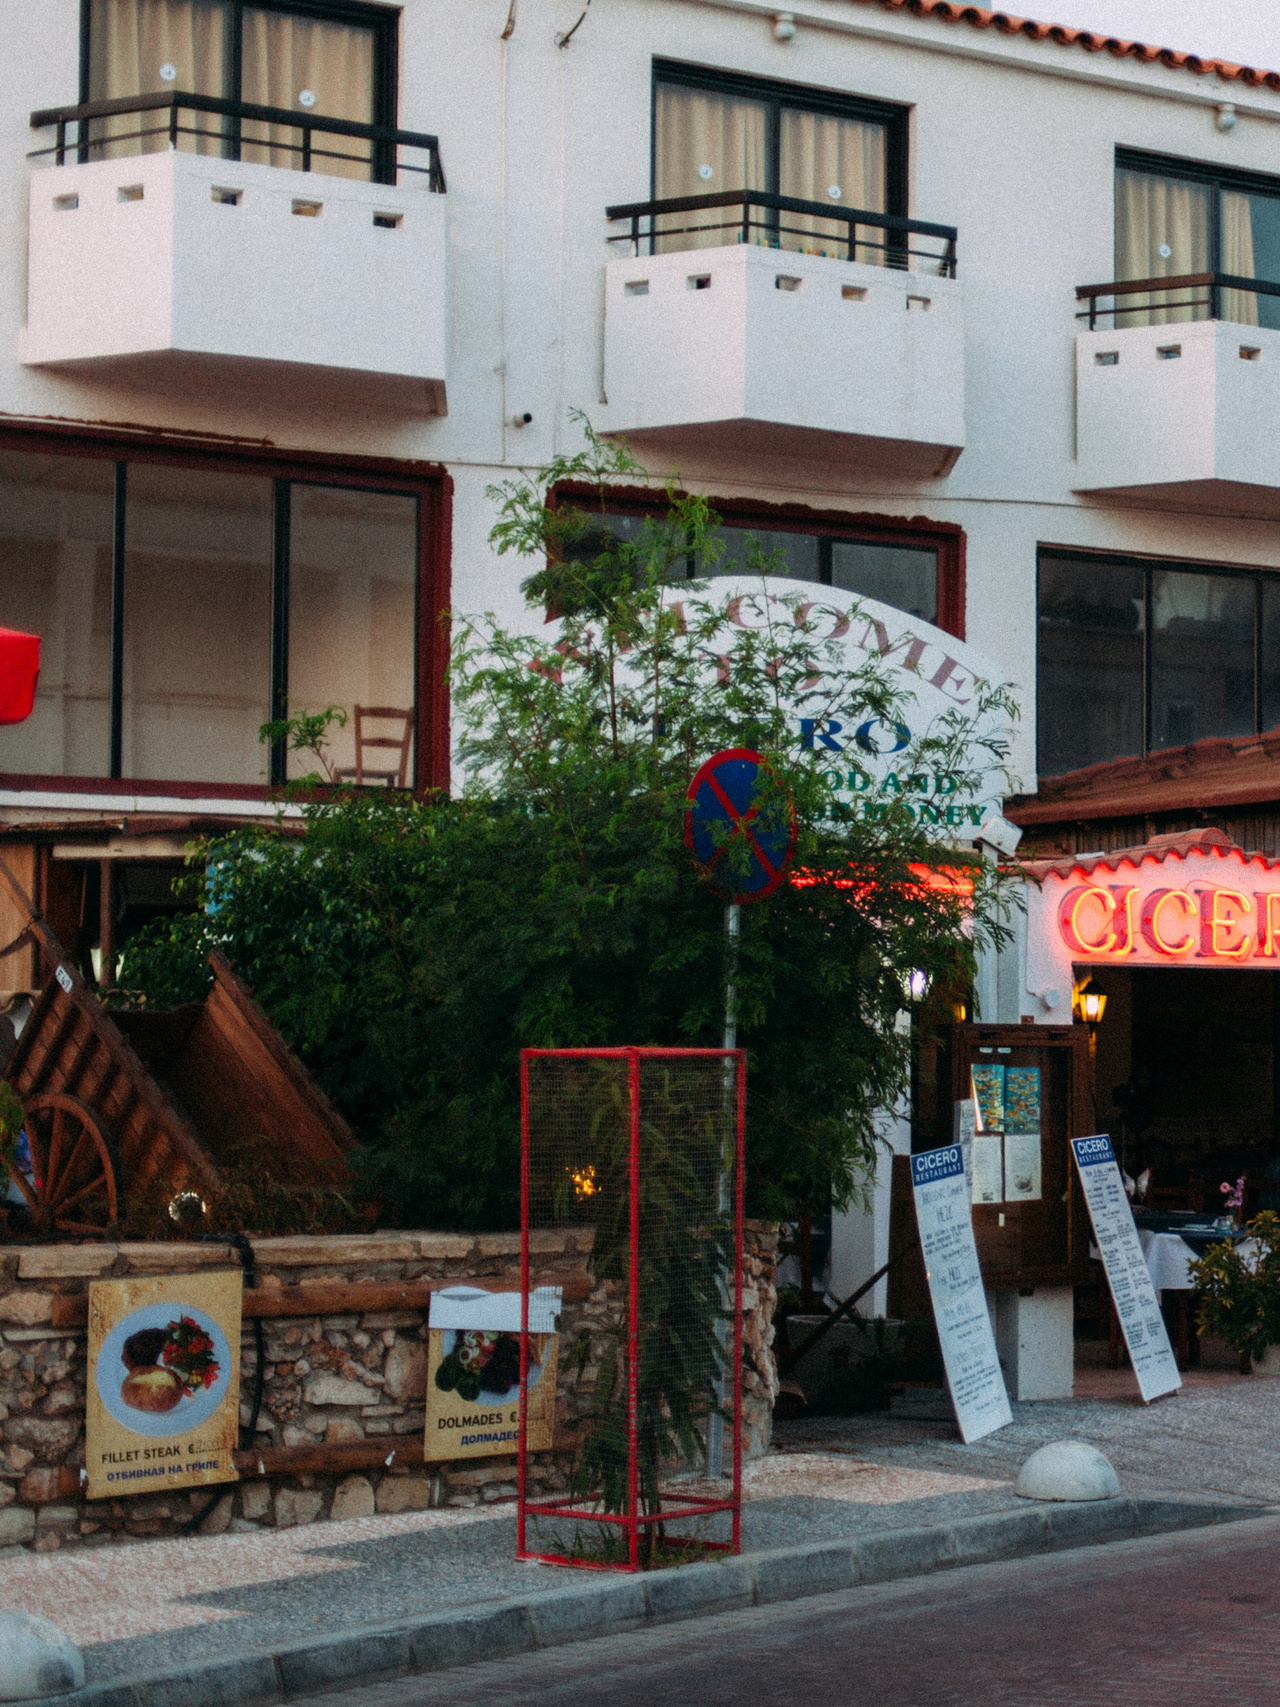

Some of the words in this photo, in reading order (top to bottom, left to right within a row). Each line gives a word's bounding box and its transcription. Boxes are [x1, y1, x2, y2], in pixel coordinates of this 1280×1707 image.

[1077, 1138, 1109, 1154] CICERO
[916, 1148, 958, 1172] CICERO
[1078, 1151, 1113, 1163] RESTAURANT
[915, 1162, 961, 1182] RESTAURANT
[438, 1413, 503, 1430] DOLMADES
[101, 1449, 141, 1464] FILLET
[144, 1445, 181, 1460] STEAK
[107, 1467, 166, 1482] ОТБИВНАЯ
[168, 1465, 183, 1475] НА
